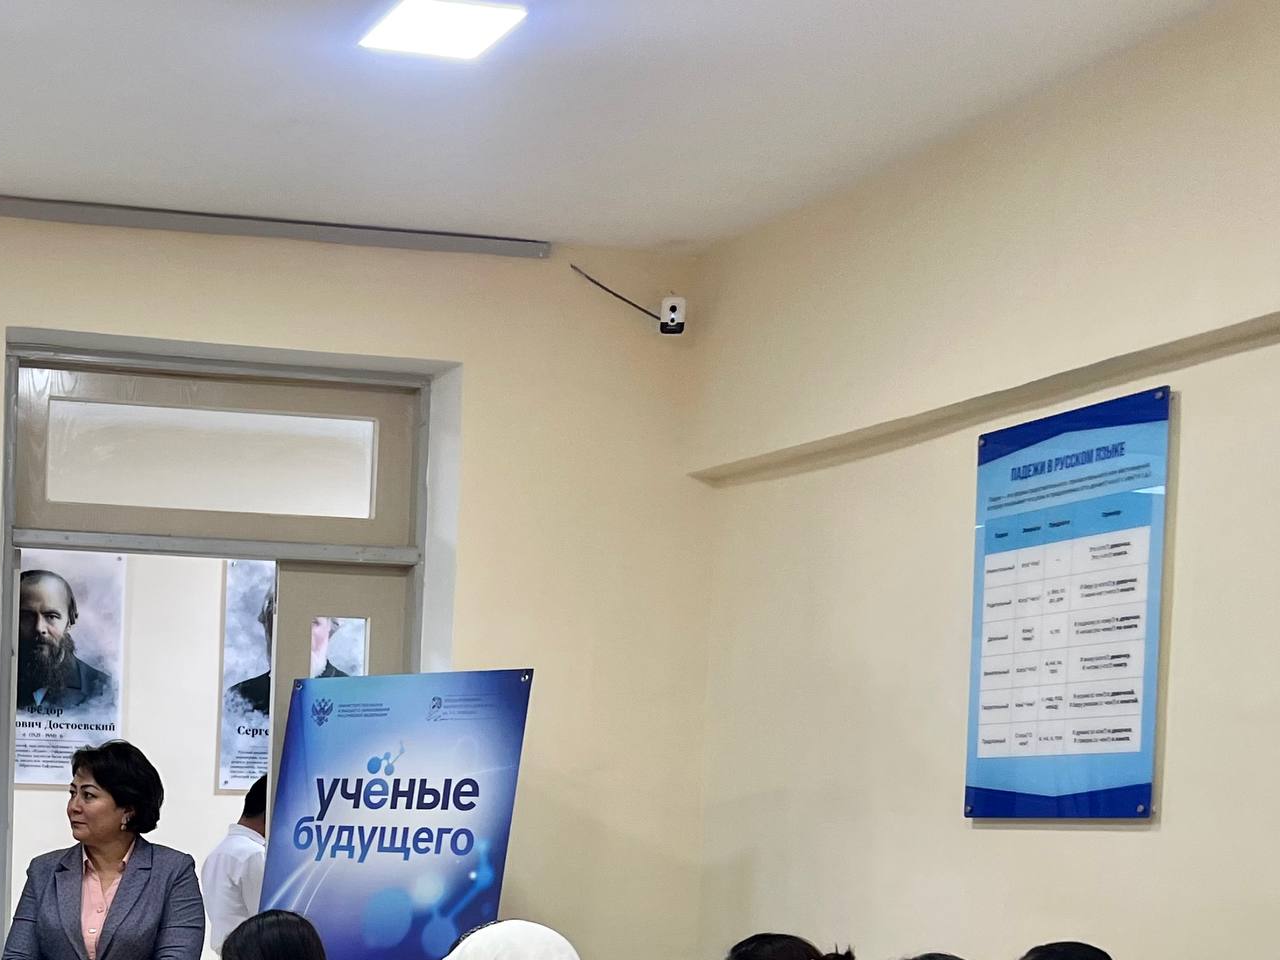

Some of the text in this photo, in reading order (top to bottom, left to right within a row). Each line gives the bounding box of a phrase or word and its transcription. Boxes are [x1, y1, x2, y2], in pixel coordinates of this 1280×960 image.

[1010, 460, 1047, 482] ПАДЕЖИ
[1047, 458, 1053, 473] В
[1053, 449, 1094, 471] РУССКОМ
[1094, 441, 1126, 462] ЯЗЫКЕ
[44, 719, 116, 731] Достоевский
[292, 815, 475, 863] будущего
